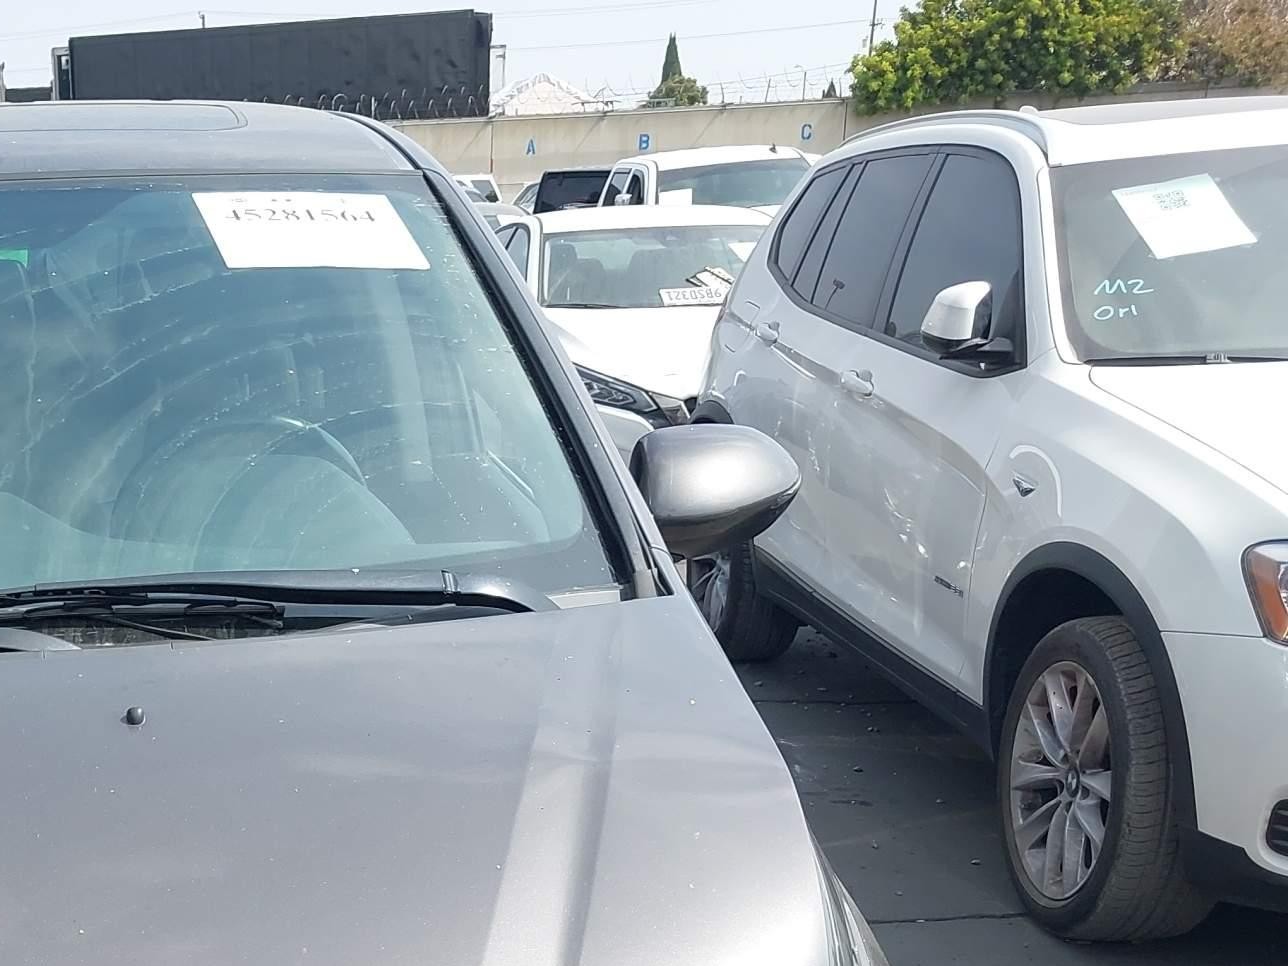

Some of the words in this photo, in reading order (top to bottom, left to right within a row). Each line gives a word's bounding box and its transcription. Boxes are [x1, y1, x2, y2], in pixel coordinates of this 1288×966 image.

[801, 123, 812, 140] C
[526, 138, 536, 155] A
[638, 133, 650, 151] B
[226, 208, 376, 222] 45281564
